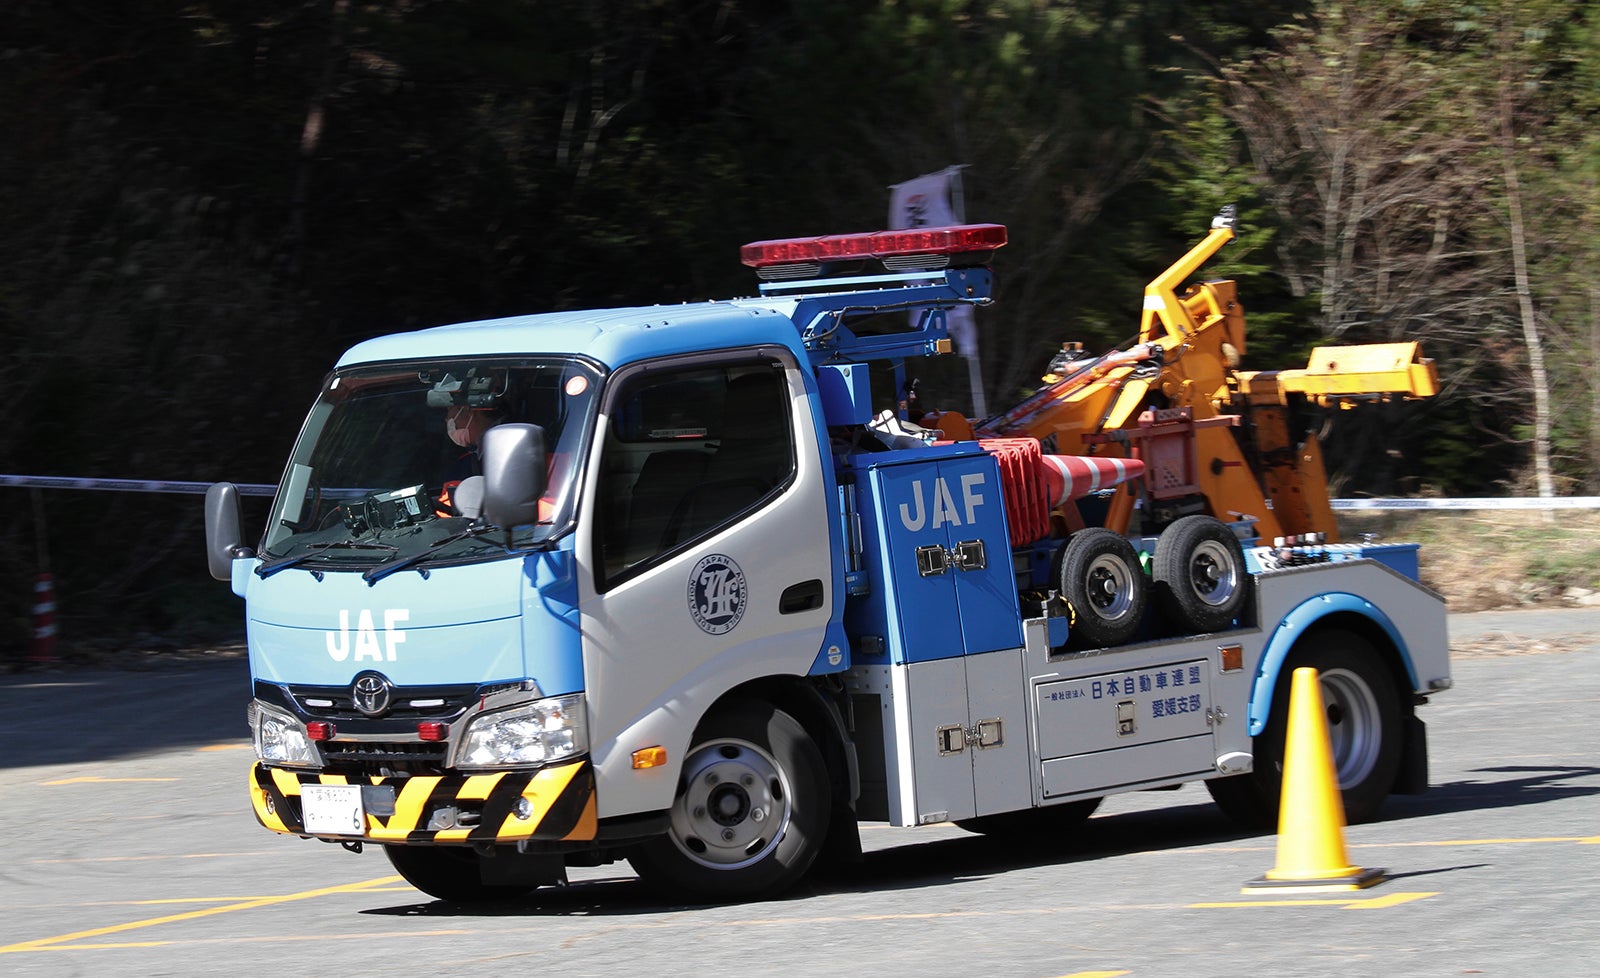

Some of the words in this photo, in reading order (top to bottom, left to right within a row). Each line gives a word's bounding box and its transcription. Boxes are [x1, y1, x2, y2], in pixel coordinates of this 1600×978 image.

[899, 472, 985, 532] JAF
[701, 556, 729, 568] JAPAN
[689, 579, 716, 632] FEDERATION
[724, 572, 746, 630] AUTOMOBILE
[325, 608, 410, 662] JAF
[1091, 665, 1202, 700] 日本自動車連盟
[1152, 693, 1202, 718] 愛媛支部
